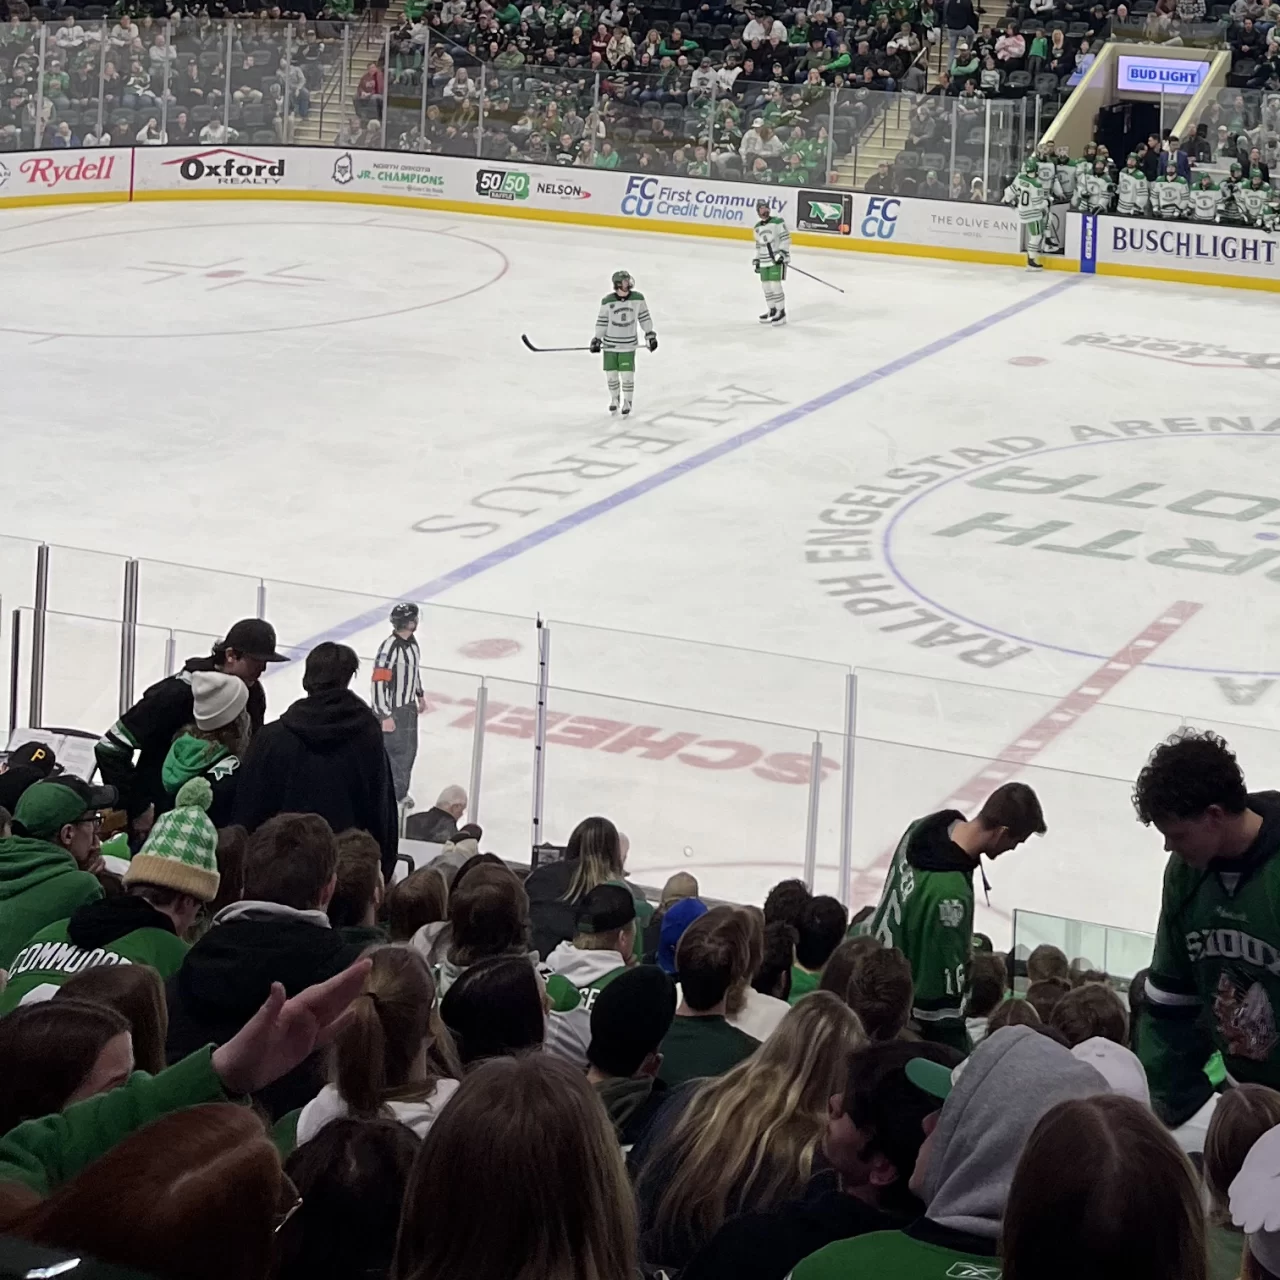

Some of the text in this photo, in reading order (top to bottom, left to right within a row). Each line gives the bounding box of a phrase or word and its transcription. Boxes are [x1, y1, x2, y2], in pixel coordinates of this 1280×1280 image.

[1130, 69, 1197, 83] BUD LIGHT
[19, 156, 115, 187] Rydell
[180, 158, 285, 180] Oxford
[357, 170, 444, 185] JR. CHAMPIONS
[480, 173, 525, 191] 50 50
[537, 183, 581, 196] NELSON
[625, 175, 659, 199] FC
[659, 187, 692, 202] First
[621, 195, 653, 216] CU
[657, 202, 743, 220] Credit Union
[865, 197, 901, 221] FC
[861, 217, 896, 239] CU
[931, 214, 1018, 231] THE OLIVE ANN
[411, 384, 792, 540] ALERUS
[805, 434, 1046, 565] ENGELSTAD
[818, 573, 1033, 669] RALPH
[30, 748, 49, 763] P
